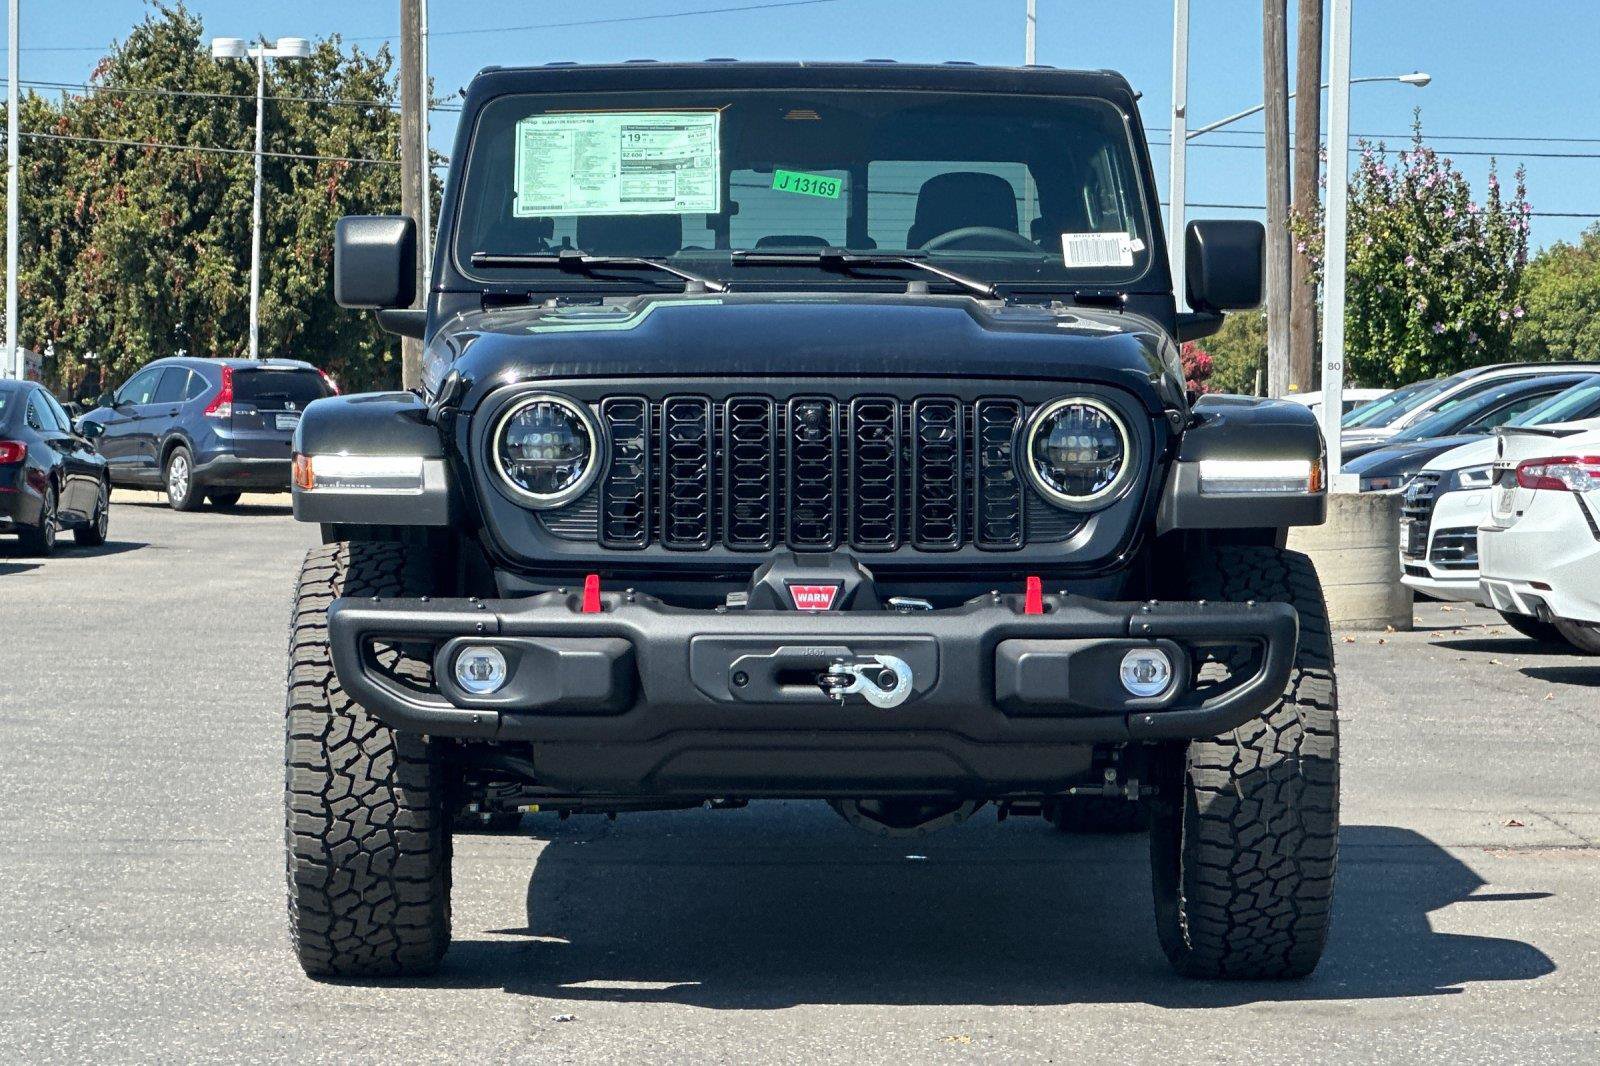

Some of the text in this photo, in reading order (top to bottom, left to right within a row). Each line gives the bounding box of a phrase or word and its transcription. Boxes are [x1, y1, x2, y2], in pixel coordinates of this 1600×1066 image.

[628, 133, 641, 142] 19
[780, 175, 836, 196] J 13169
[1328, 362, 1341, 371] 80
[797, 593, 829, 602] WARN
[802, 647, 825, 656] Jeep
